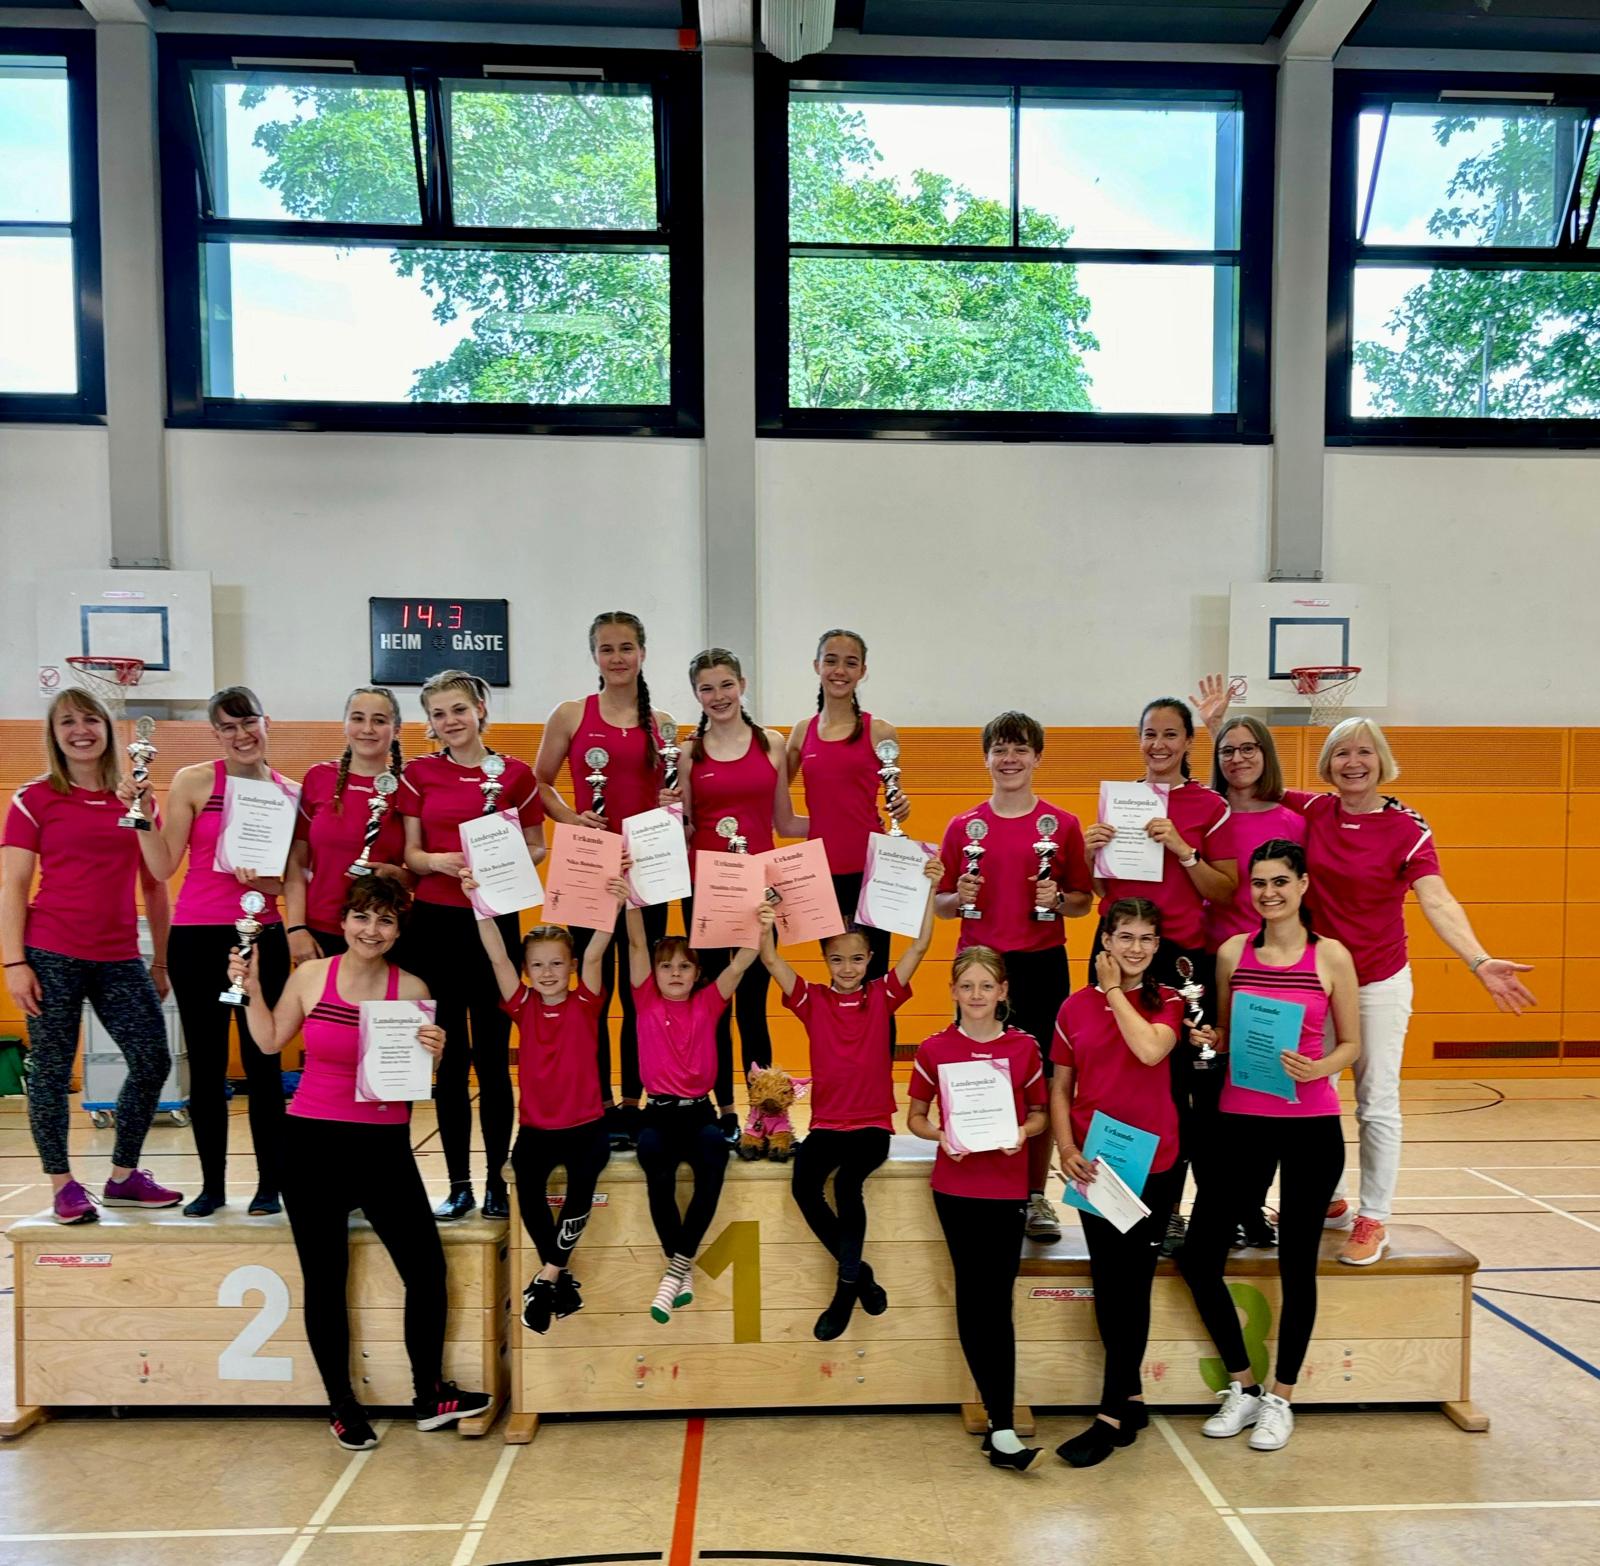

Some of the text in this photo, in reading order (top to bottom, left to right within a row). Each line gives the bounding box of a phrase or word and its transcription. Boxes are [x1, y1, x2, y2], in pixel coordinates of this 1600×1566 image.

[380, 633, 422, 650] HEIM
[452, 630, 504, 651] GÄSTE
[572, 833, 604, 845] Urkunde
[773, 852, 804, 864] Urkunde
[1249, 1003, 1281, 1016] Urkunde
[1104, 1125, 1135, 1142] Urkunde
[696, 1221, 761, 1343] 1
[217, 1265, 293, 1381] 2
